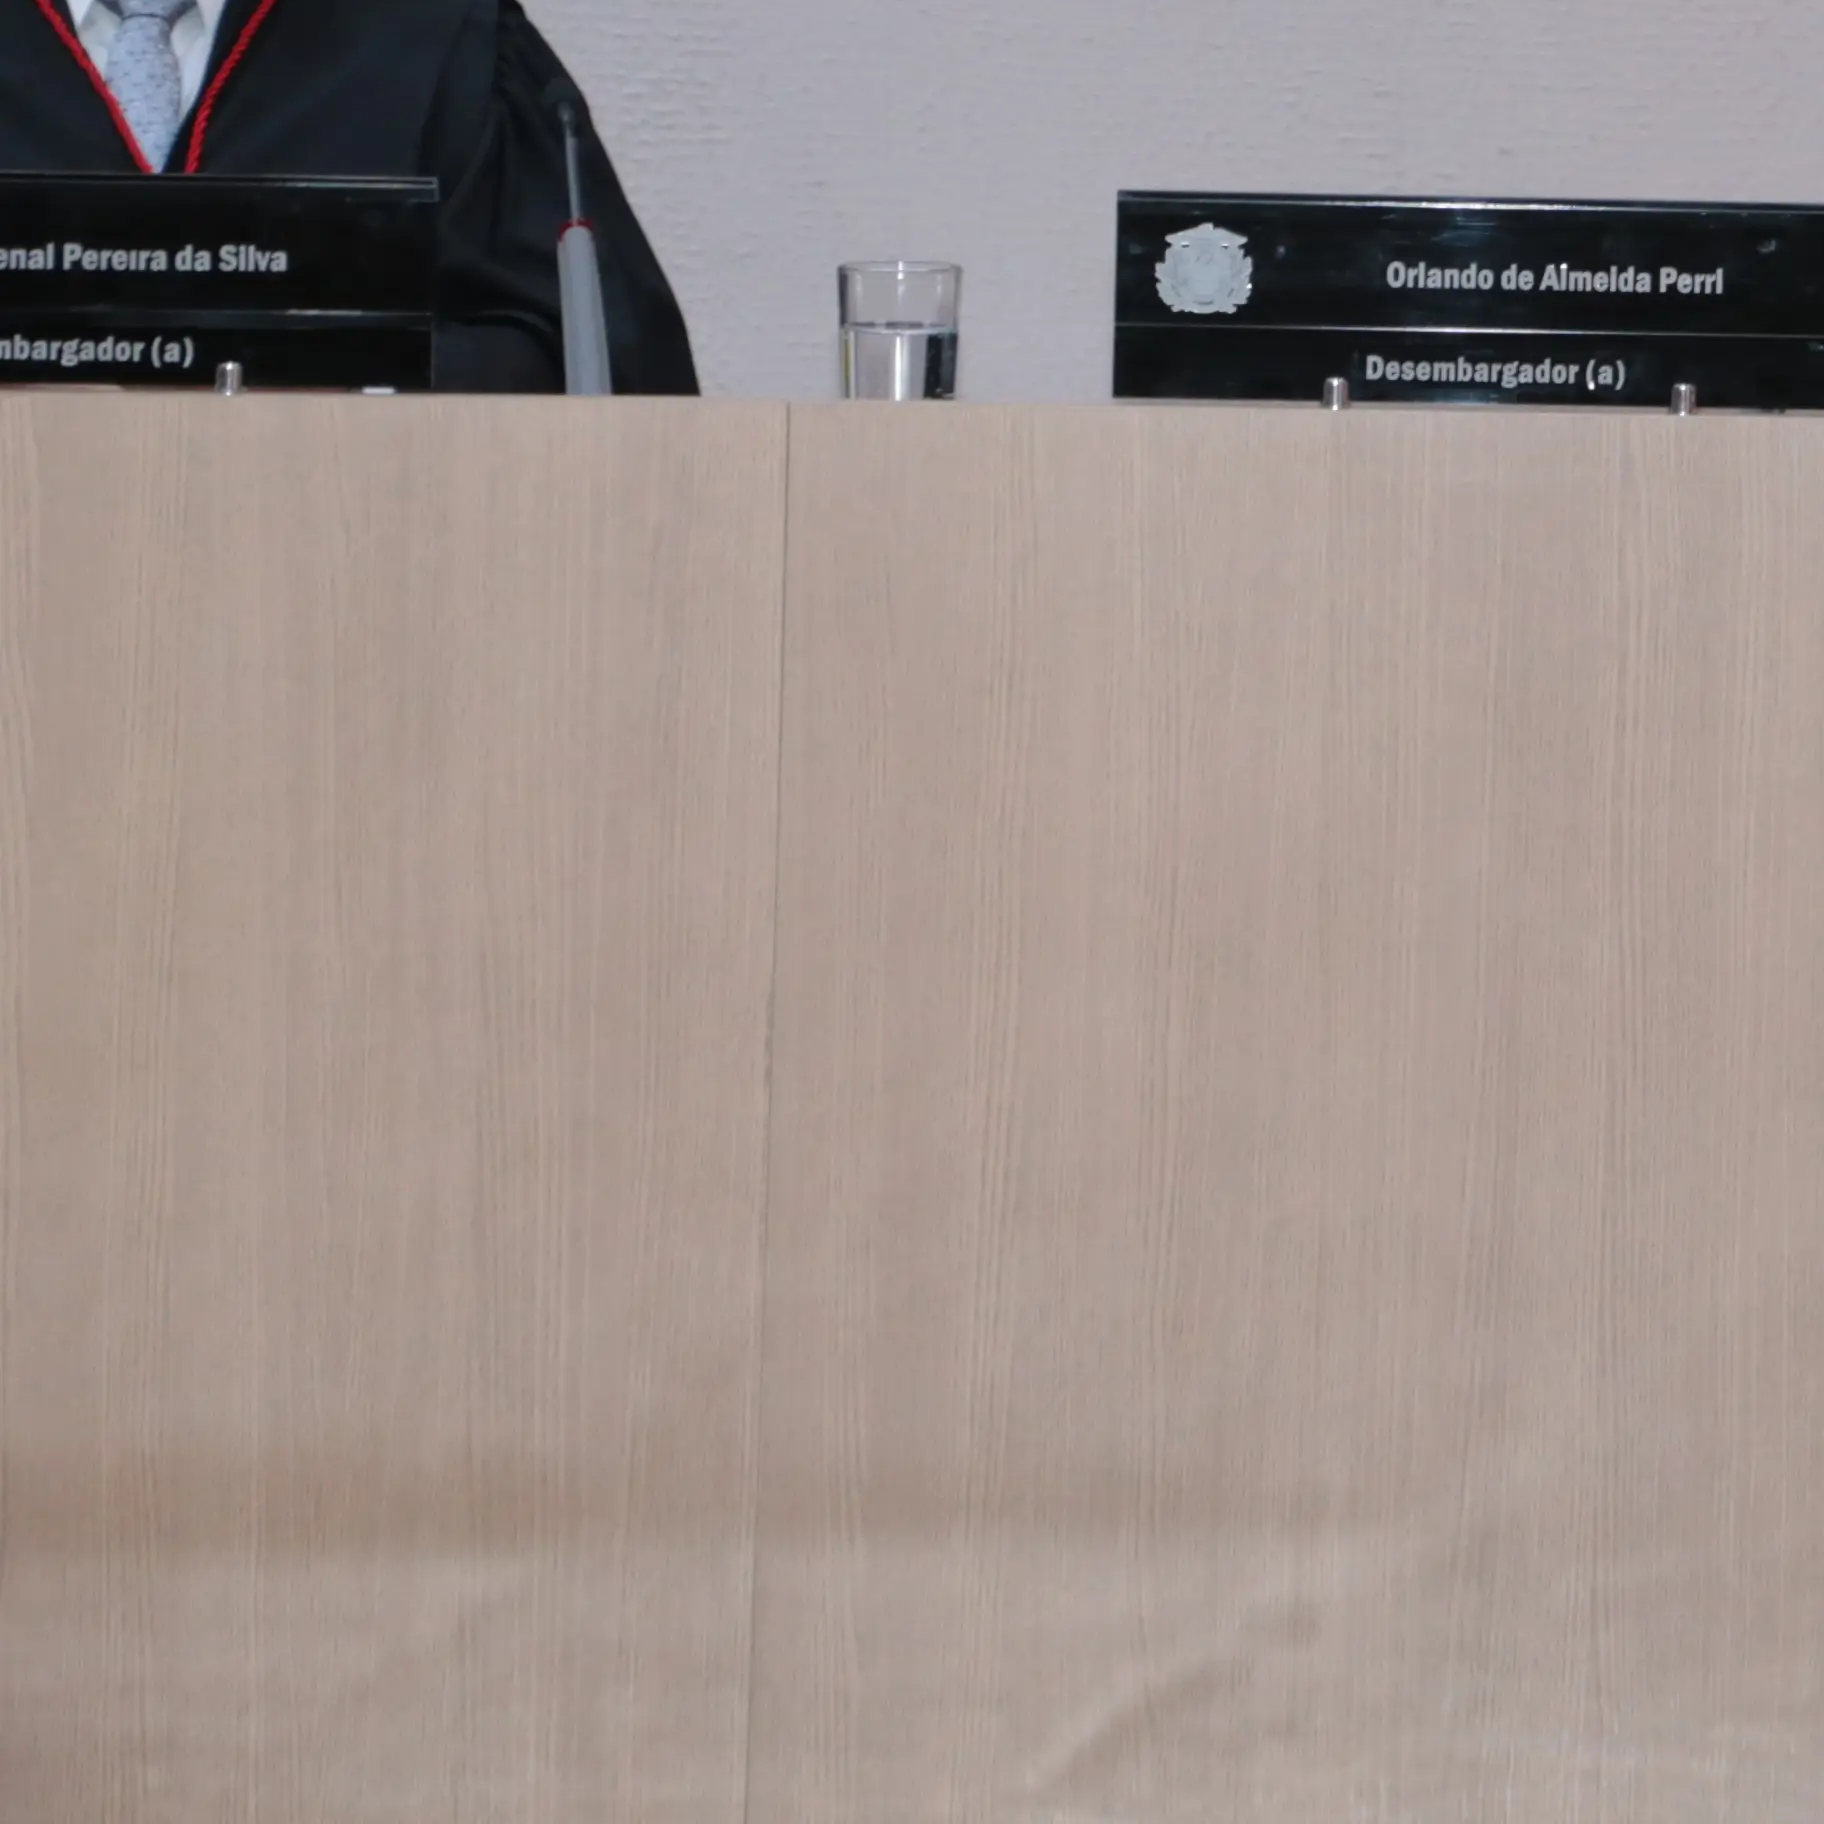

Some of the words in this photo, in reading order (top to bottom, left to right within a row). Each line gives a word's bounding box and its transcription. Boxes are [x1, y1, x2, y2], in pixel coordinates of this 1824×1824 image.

[62, 243, 168, 272] Pereira
[174, 244, 212, 272] da
[218, 244, 289, 273] Silva
[1386, 261, 1494, 291] Orlando
[1500, 263, 1535, 291] de
[1539, 262, 1652, 293] Almeida
[150, 336, 195, 369] (a)
[1366, 354, 1580, 389] Desembargador
[1585, 359, 1626, 391] (a)
